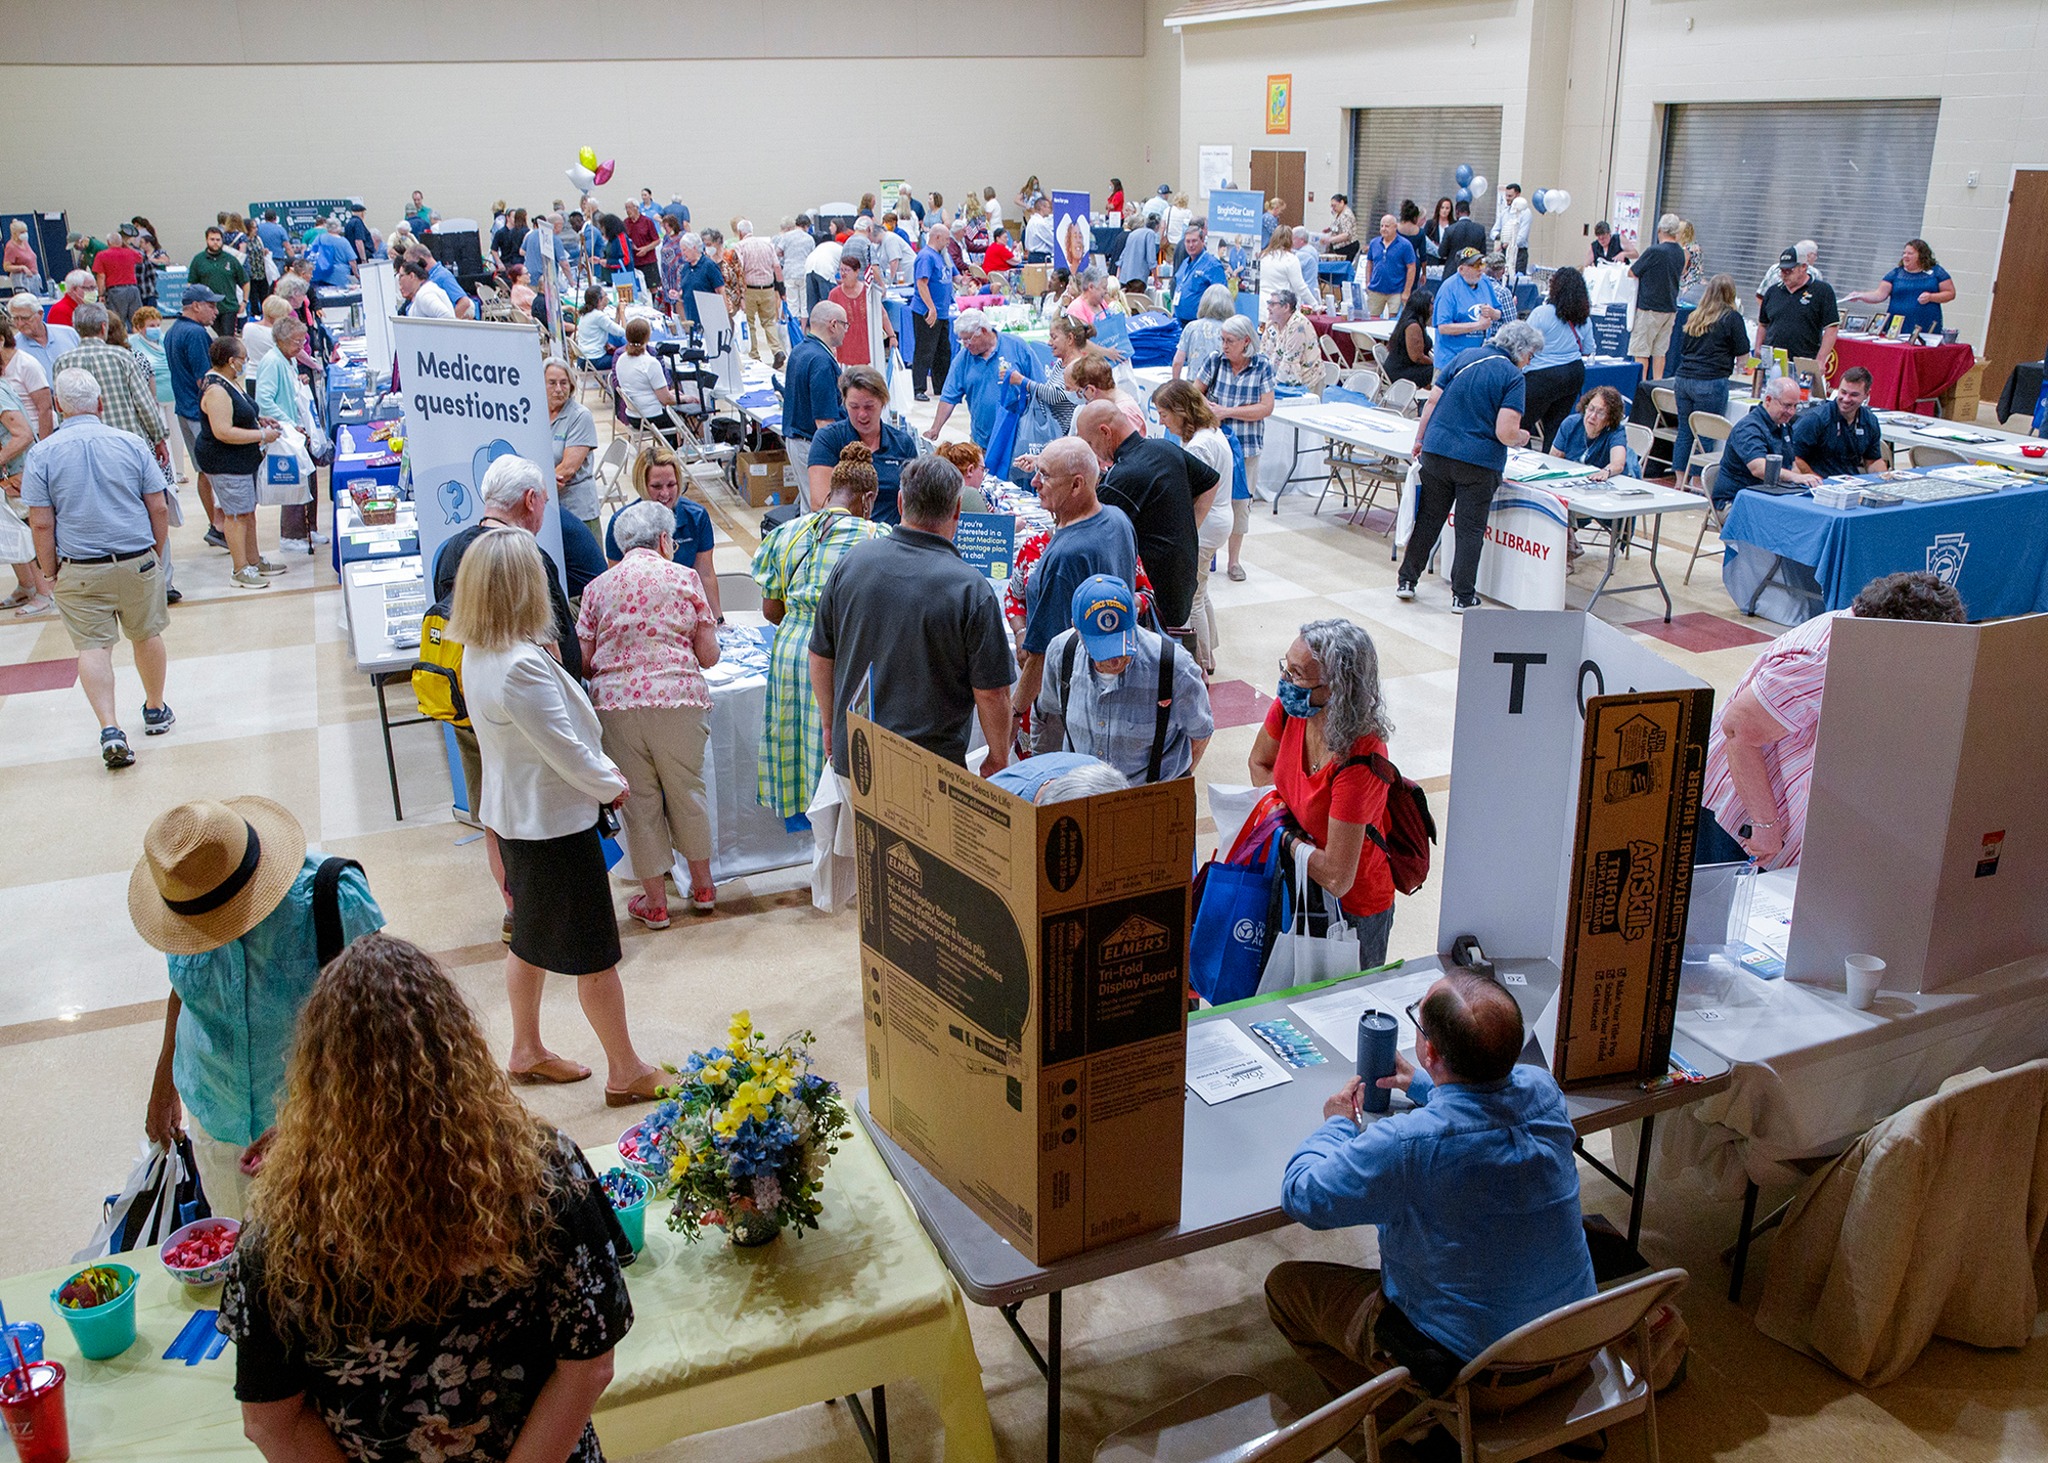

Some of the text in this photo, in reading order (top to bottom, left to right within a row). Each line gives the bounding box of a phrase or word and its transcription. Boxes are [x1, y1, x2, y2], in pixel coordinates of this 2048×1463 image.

[417, 351, 520, 386] Medicare
[414, 391, 531, 424] questions?
[957, 543, 990, 553] Advantage
[977, 536, 1006, 544] Medicare
[1496, 529, 1550, 560] LIBRARY
[937, 764, 1011, 809] Bring Your Ideas to Life
[1683, 772, 1700, 826] HEADER
[951, 790, 1008, 824] www.elmers.com
[888, 857, 921, 882] ELMER'S
[1673, 829, 1694, 914] DETACHABLE
[887, 887, 915, 912] Panneau
[887, 873, 956, 927] Tri-Fold Display Board
[1592, 853, 1608, 933] DISPLAY BOARD
[1602, 857, 1620, 925] TRIFOLD
[1625, 839, 1658, 941] ArtSkills
[888, 899, 911, 922] Tablero
[935, 931, 950, 947] para
[951, 942, 1003, 983] presentaciones
[1104, 935, 1164, 960] ELMER'S
[1669, 944, 1678, 969] BOARD
[1099, 967, 1177, 995] Display Board
[1100, 960, 1143, 981] Tri-Fold
[1666, 971, 1675, 1000] DISPLAY
[1590, 984, 1602, 1031] Get Noticed!
[1598, 982, 1613, 1062] Stabilize Your Trifold
[1607, 980, 1624, 1057] Make Your Title Pop
